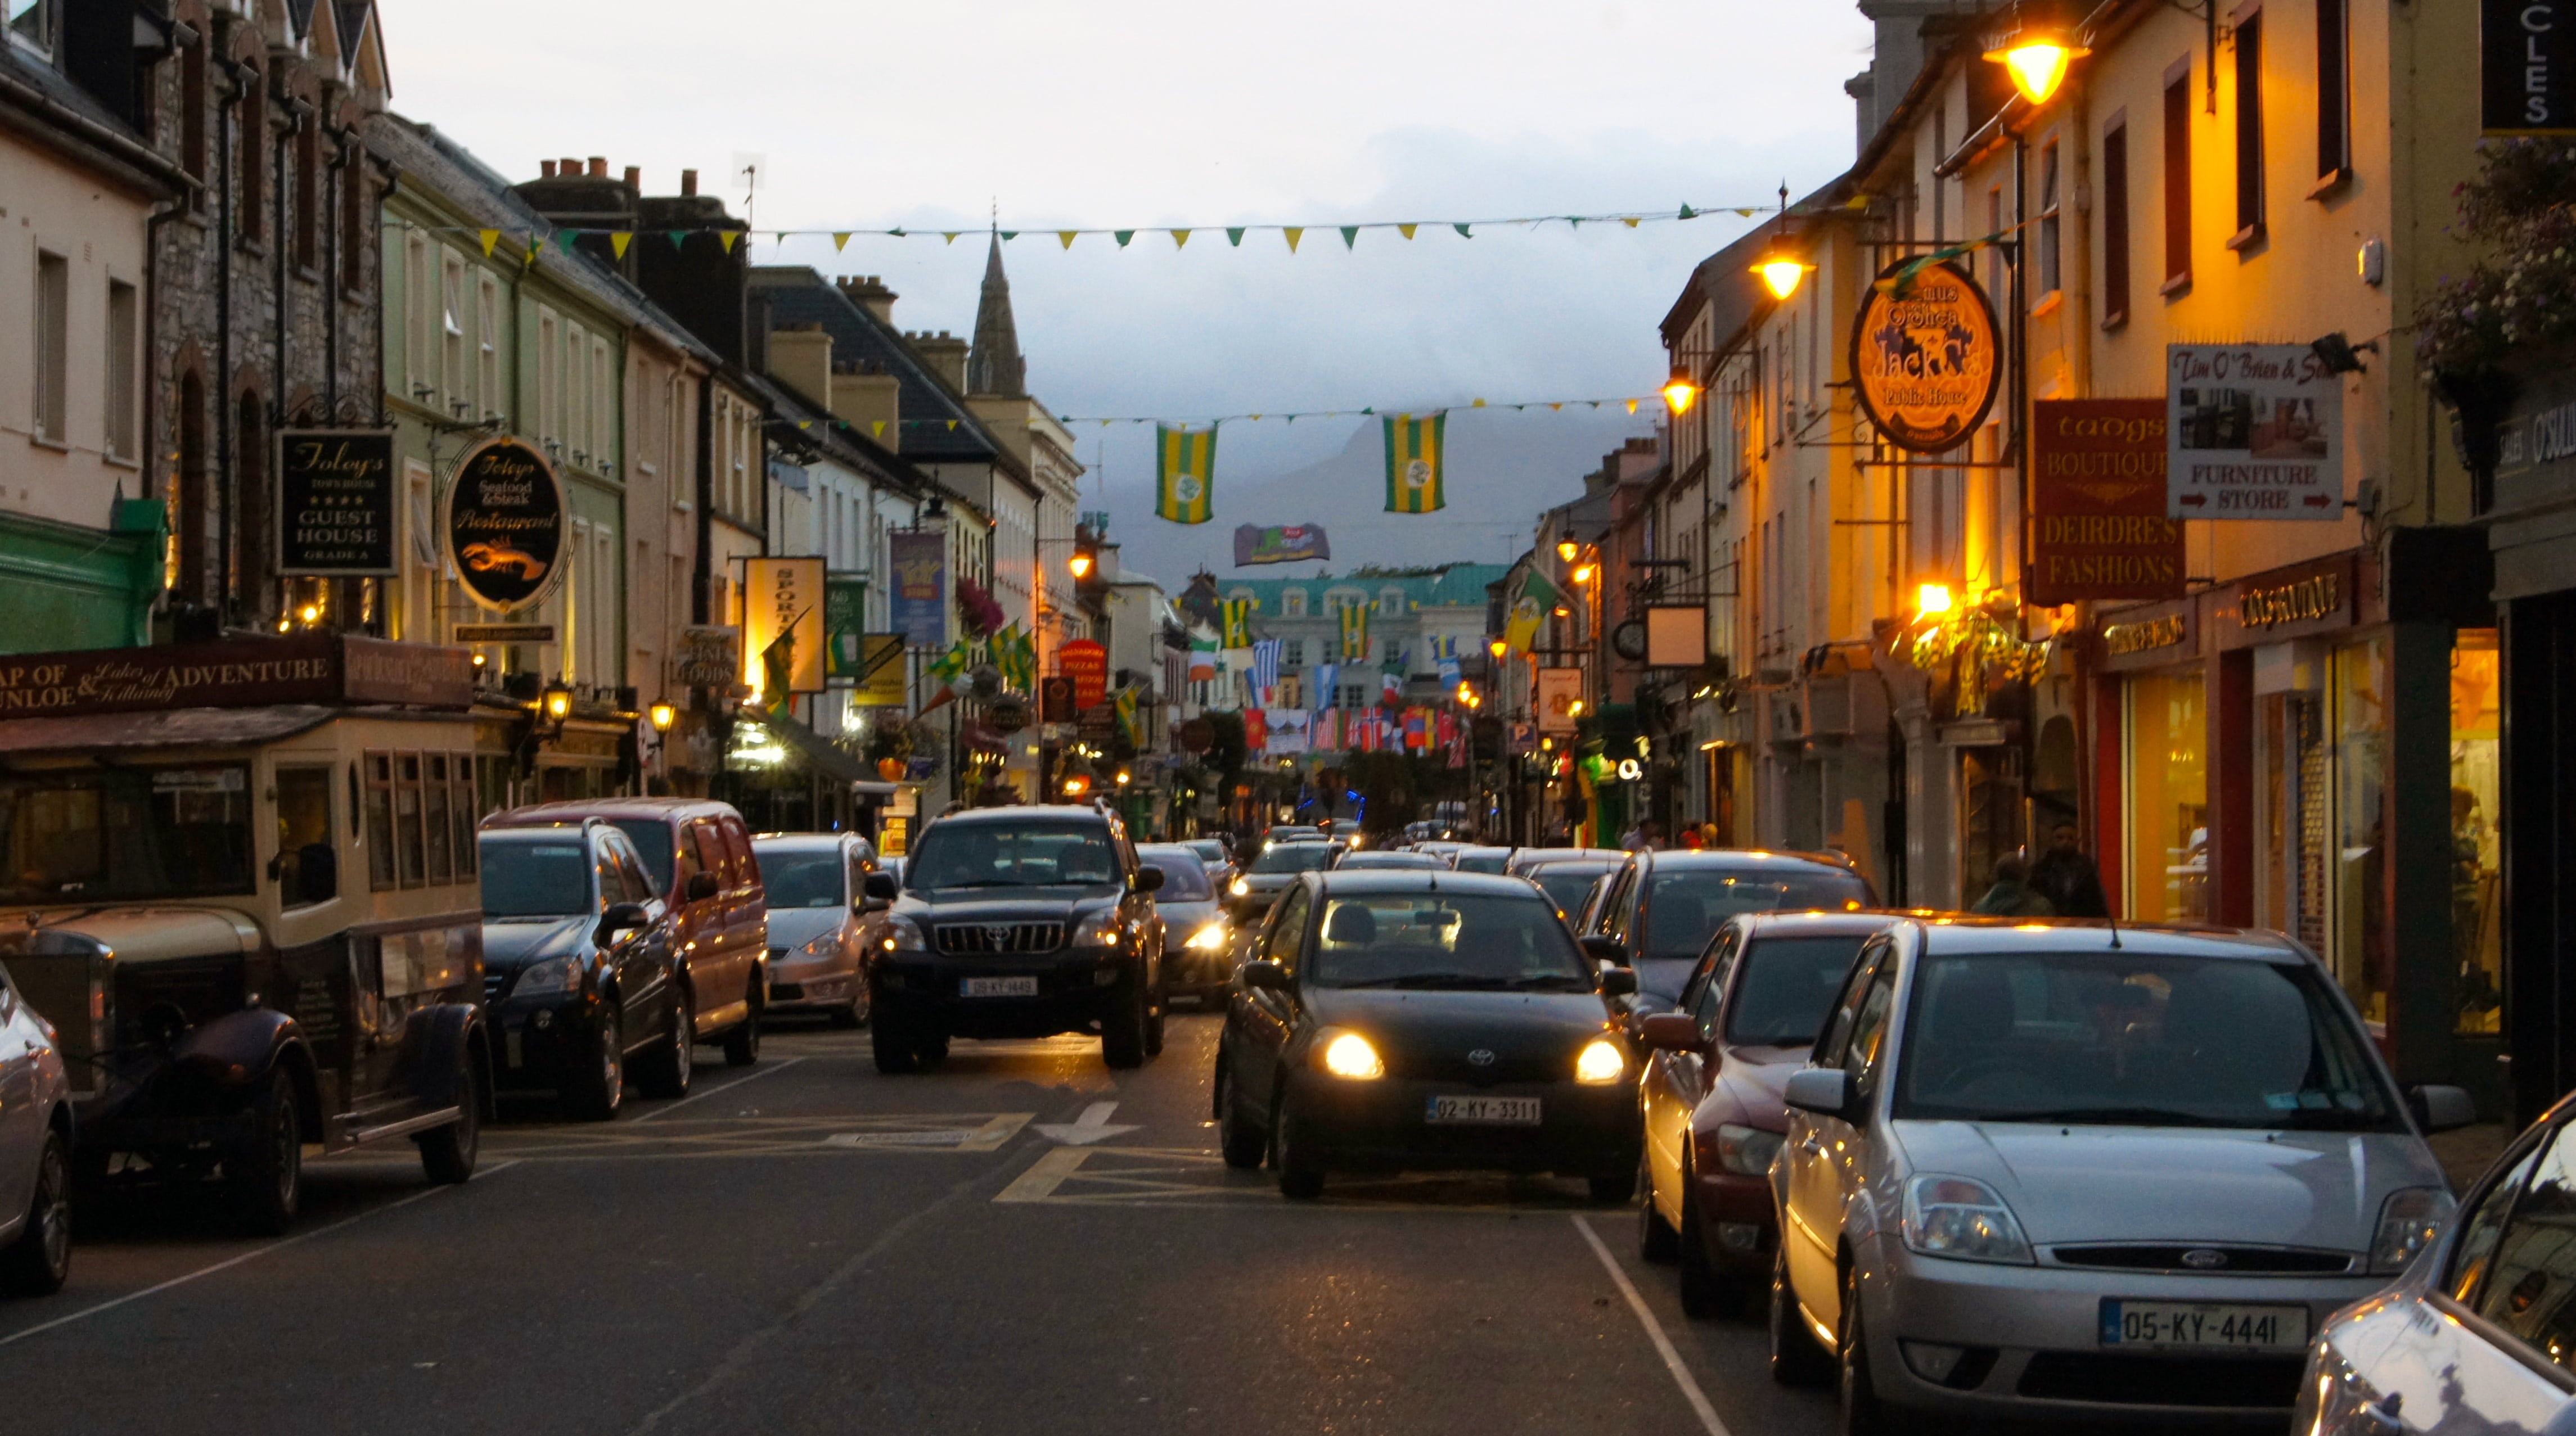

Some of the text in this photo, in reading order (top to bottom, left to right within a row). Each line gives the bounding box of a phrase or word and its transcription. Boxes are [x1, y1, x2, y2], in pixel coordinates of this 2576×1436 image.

[1873, 339, 1939, 380] Jack
[2174, 350, 2336, 386] Tim O'Brien & Son
[1885, 389, 1967, 406] Public House
[290, 441, 384, 478] Foley's
[2191, 464, 2318, 485] FURNITURE
[479, 480, 533, 494] Seafood
[2217, 489, 2289, 509] STORE
[299, 510, 376, 525] GUEST
[457, 508, 557, 530] Restaurant
[297, 528, 379, 544] HOUSE
[2044, 515, 2177, 545] DEIRDRE'S
[304, 550, 368, 560] GRADE A
[2049, 555, 2176, 585] FASHIONS
[34, 664, 67, 685] OF
[95, 662, 163, 686] Lakes of
[166, 658, 327, 689] ADVENTURE
[681, 666, 733, 683] FOODS
[1065, 661, 1100, 670] PIZZAS
[78, 673, 99, 696] &
[96, 683, 176, 702] Killarney
[0, 685, 76, 709] NLOE
[1515, 725, 1528, 740] P
[1438, 1100, 1537, 1120] 02-KY-3311
[2125, 1311, 2277, 1344] 05-KY-4441
